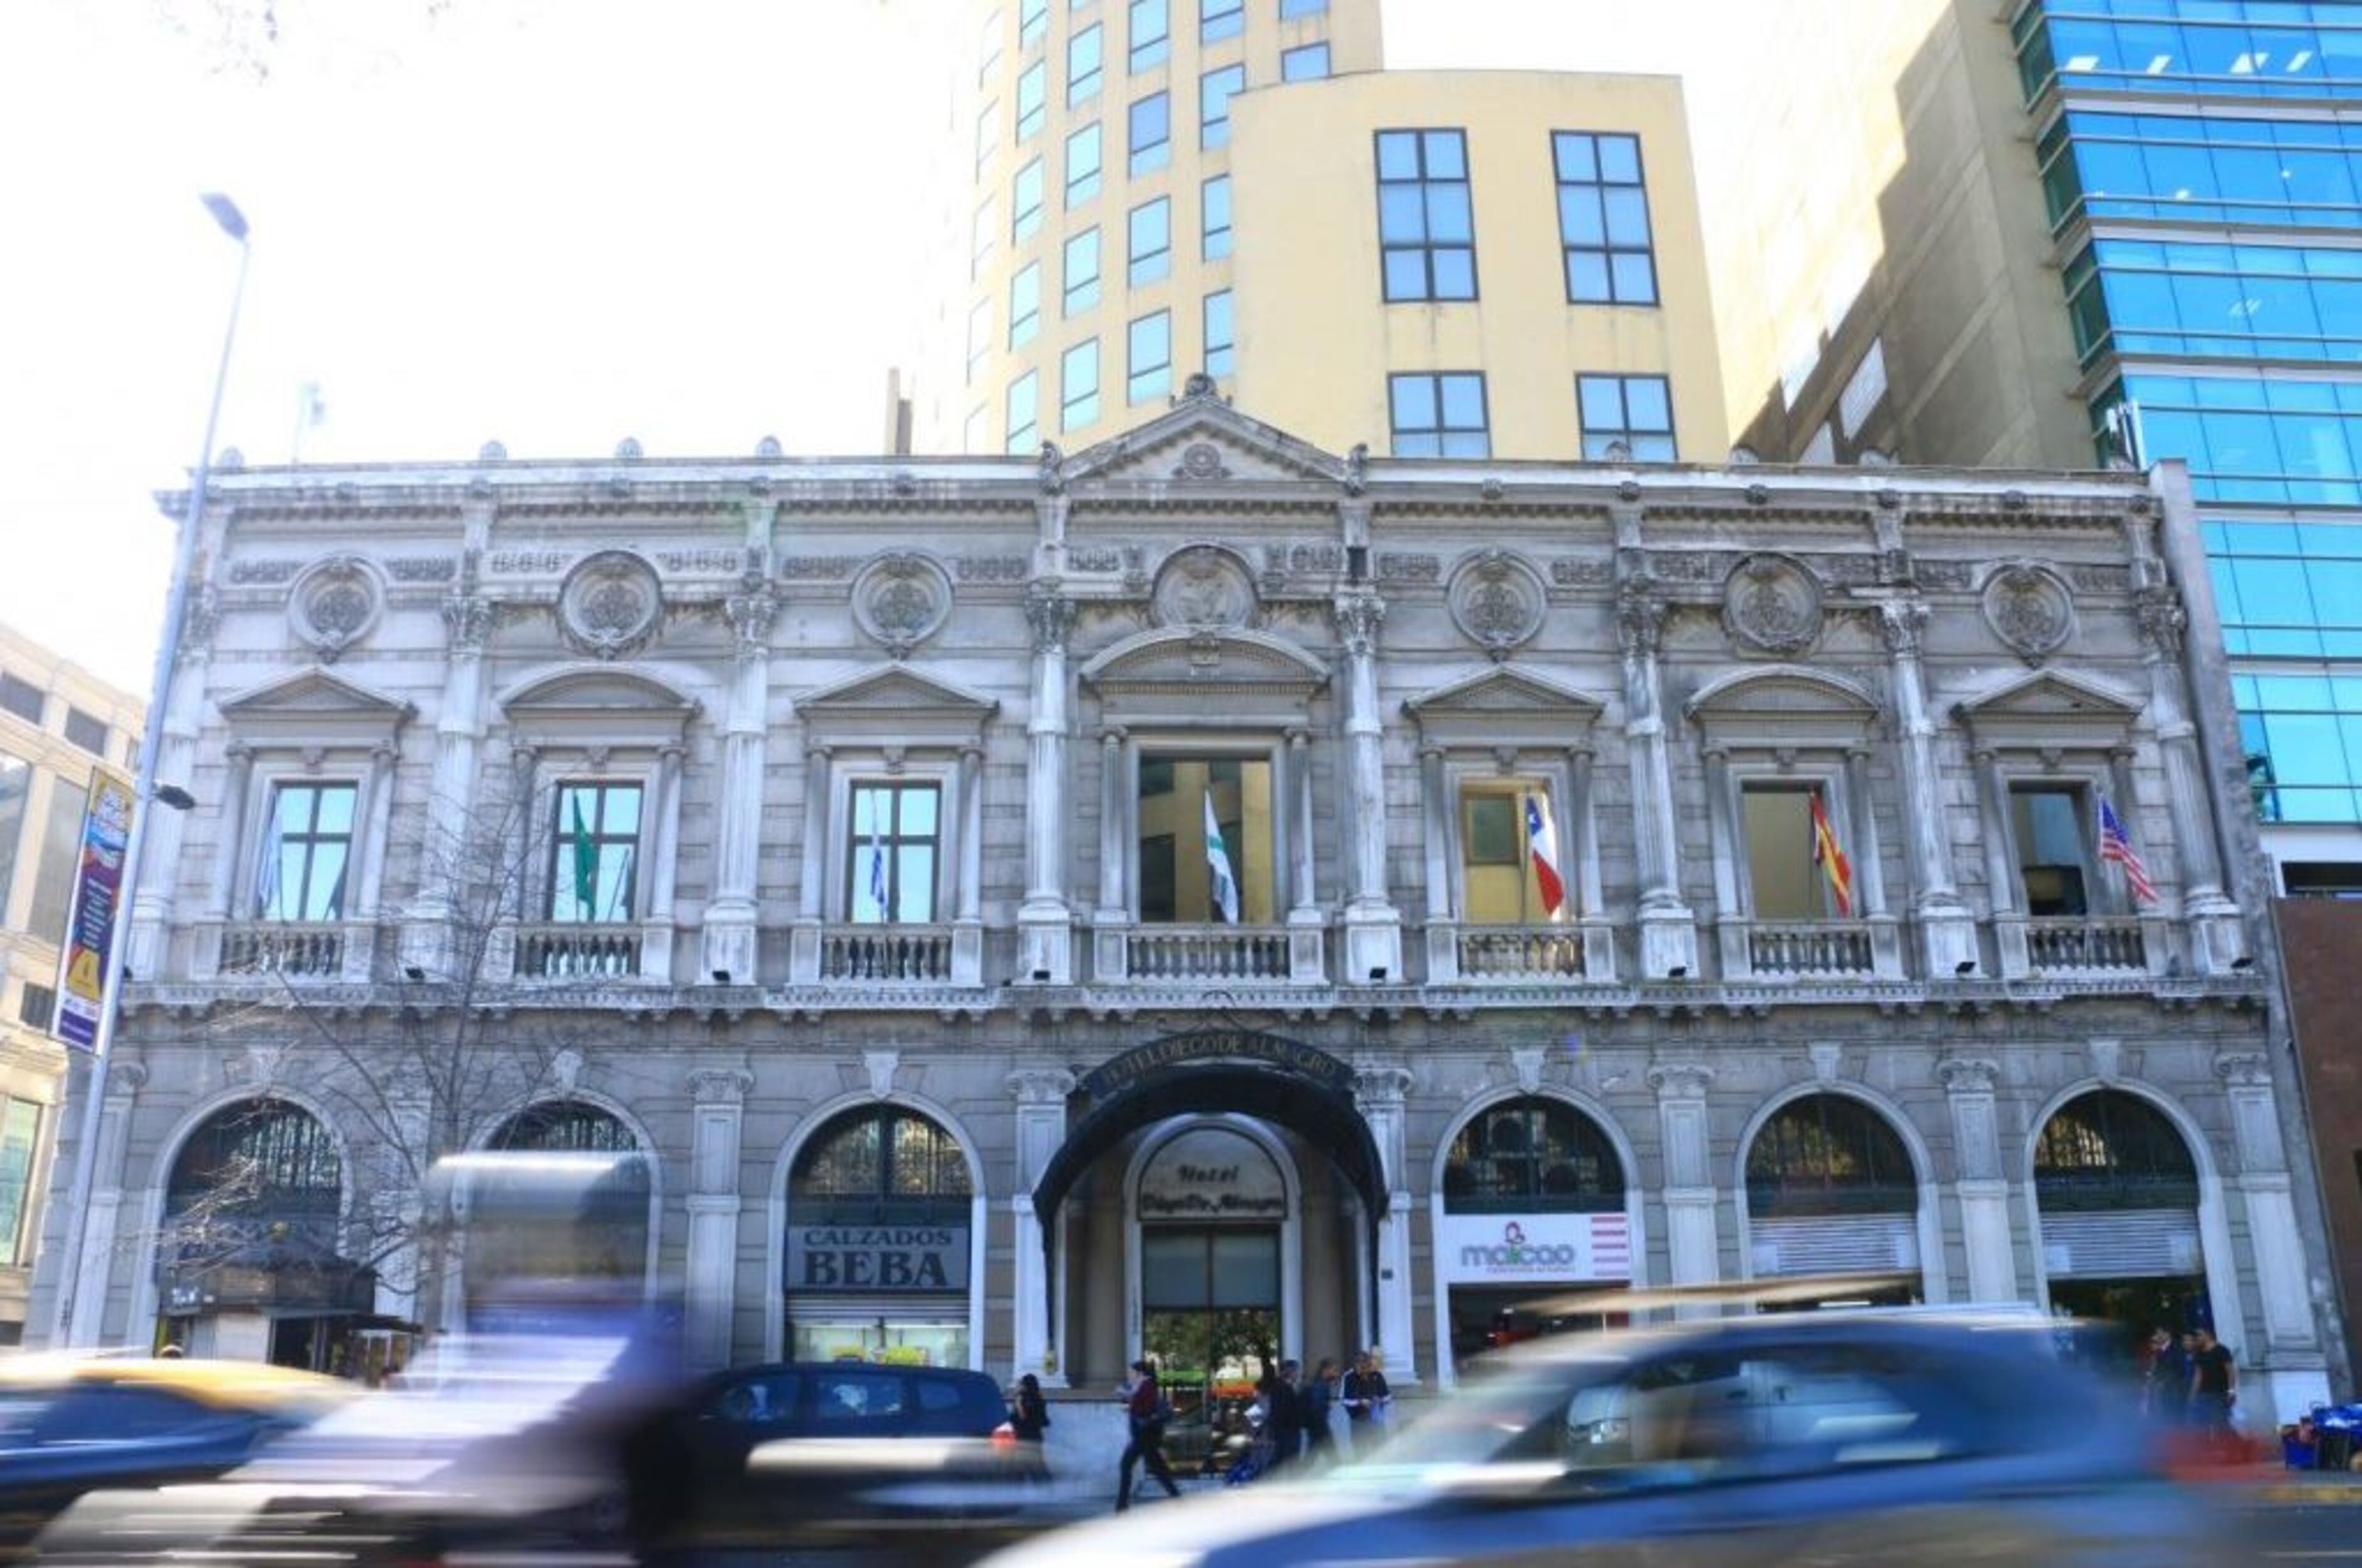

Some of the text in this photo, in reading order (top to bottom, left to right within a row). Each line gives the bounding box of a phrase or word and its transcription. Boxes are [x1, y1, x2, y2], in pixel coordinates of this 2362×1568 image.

[804, 1228, 952, 1246] CALZADOS
[1461, 1243, 1577, 1267] maicao
[804, 1251, 948, 1286] BEBA
